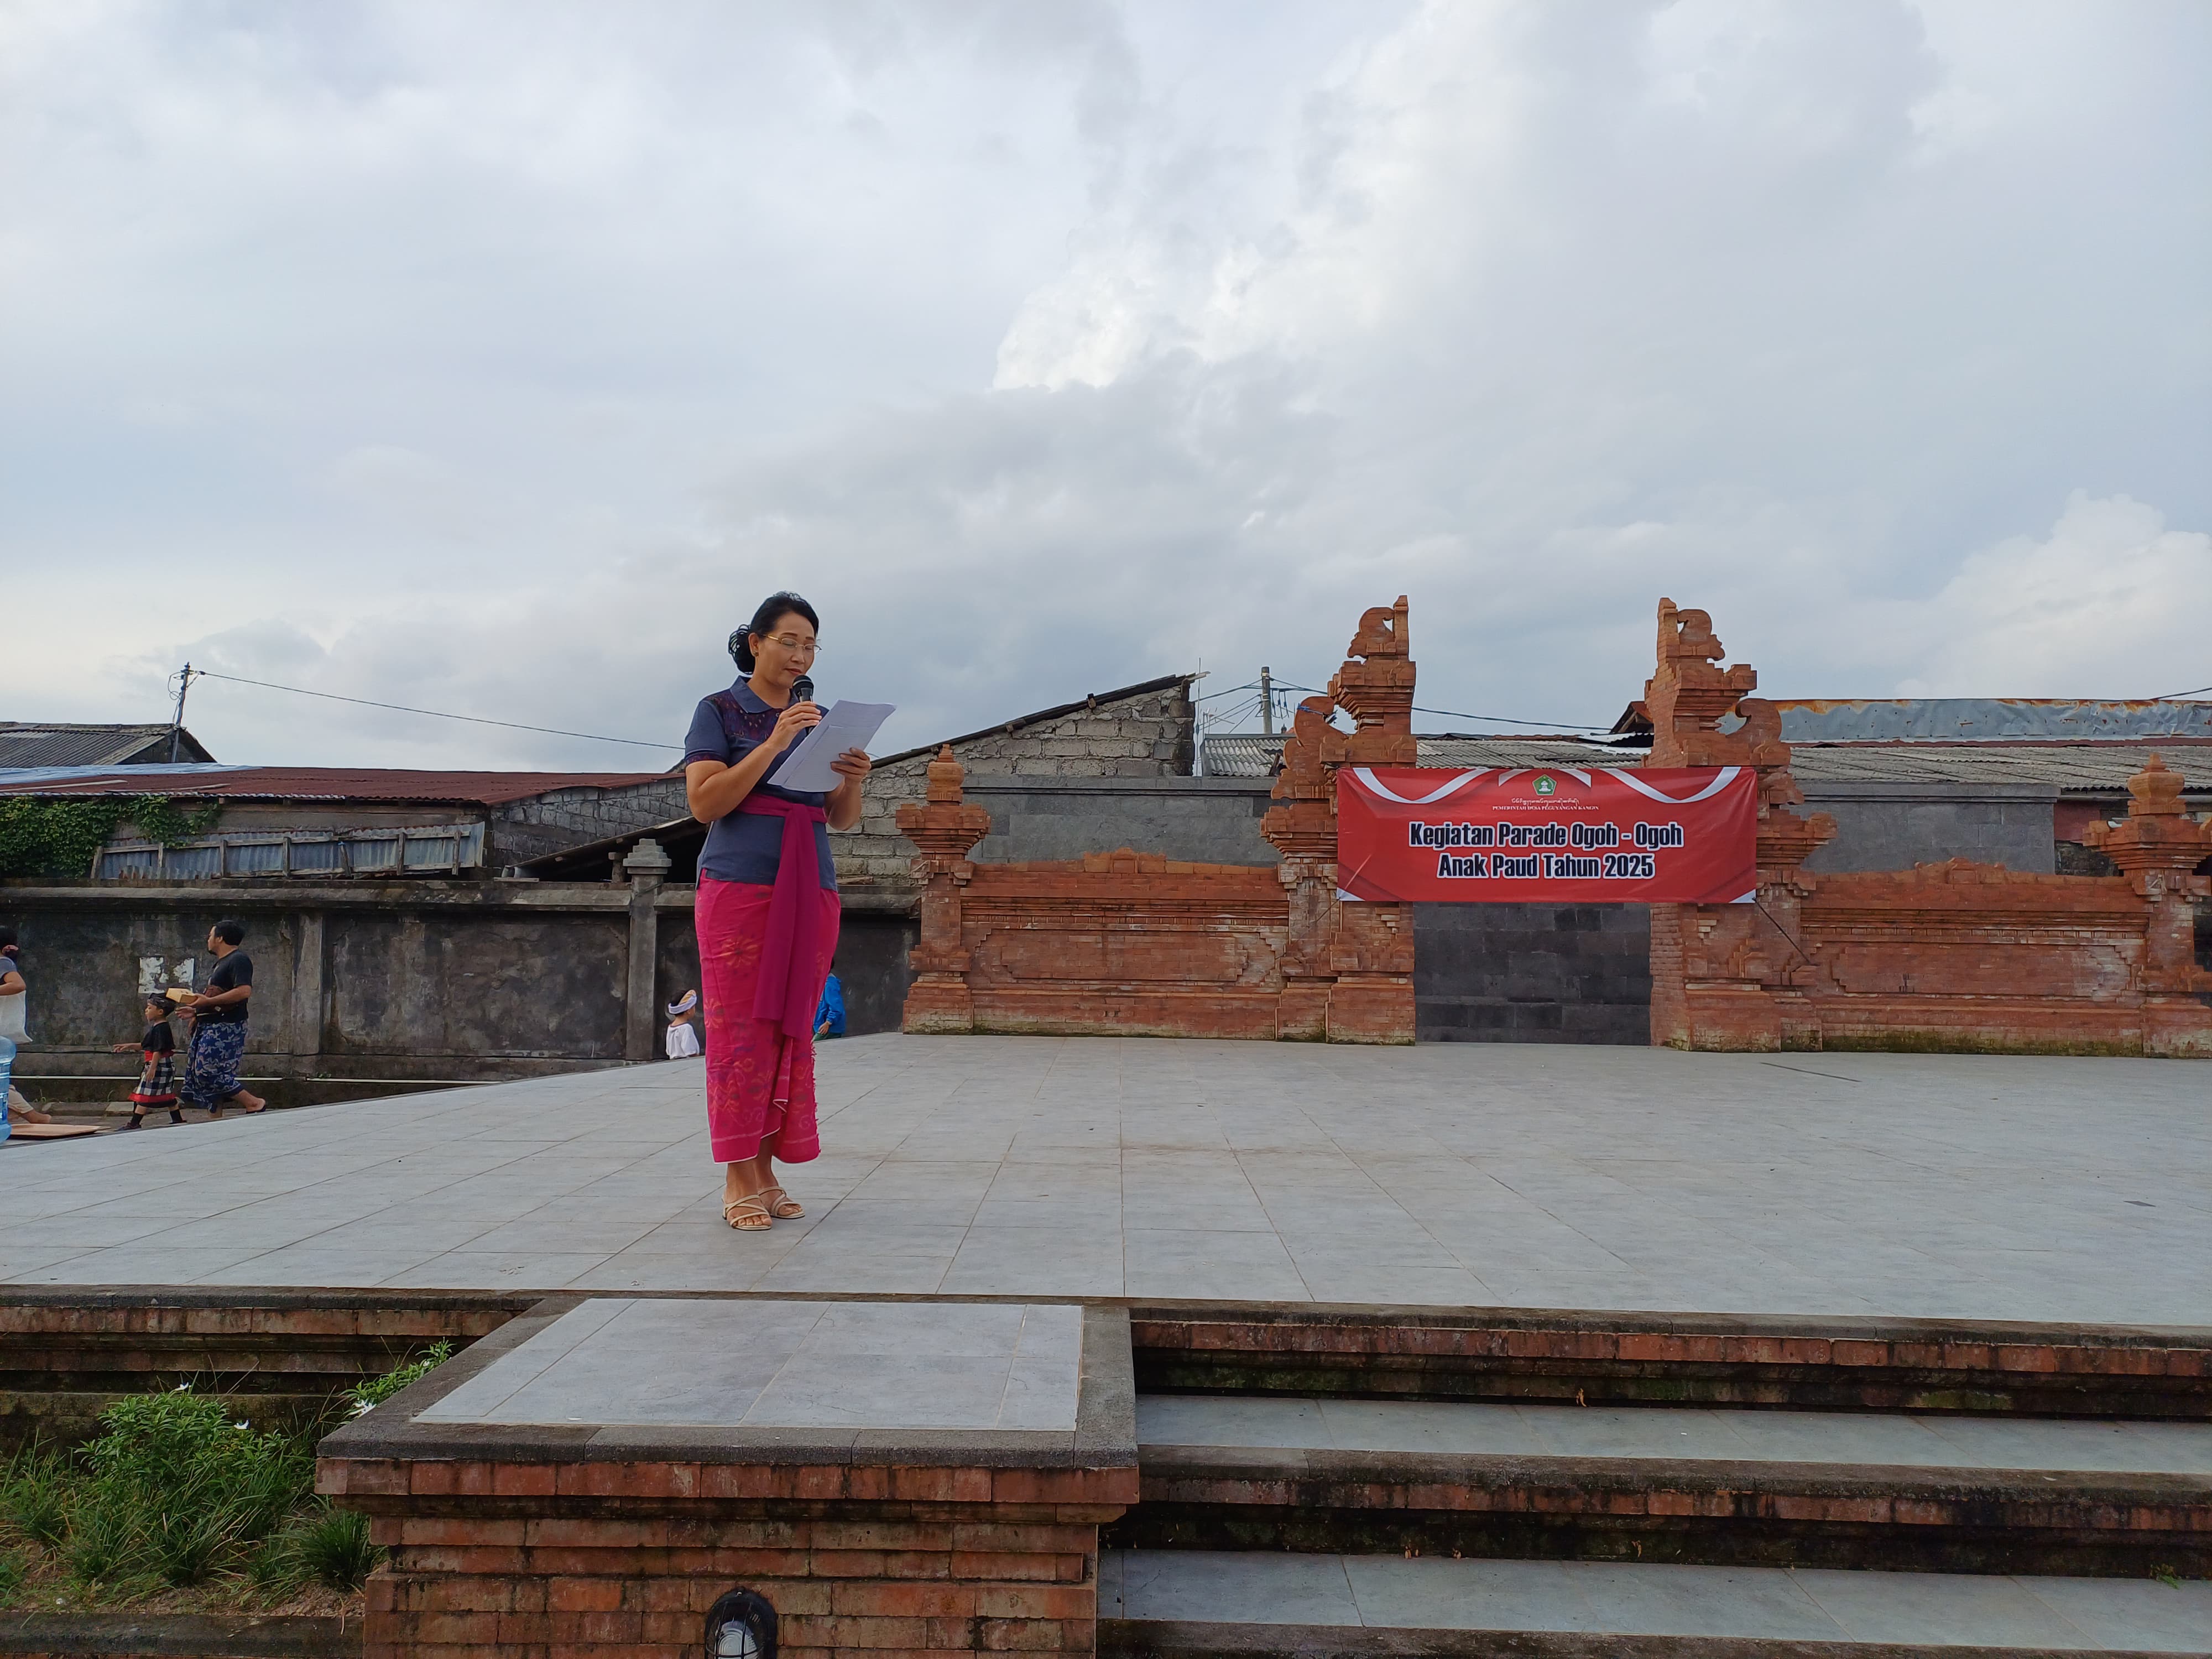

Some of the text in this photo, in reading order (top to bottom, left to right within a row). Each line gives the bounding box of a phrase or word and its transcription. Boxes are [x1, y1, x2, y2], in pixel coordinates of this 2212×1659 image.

[1409, 822, 1494, 851] Kegiatan
[1497, 822, 1568, 847] Parade
[1571, 822, 1619, 851] Ogoh
[1634, 822, 1684, 851] Ogoh
[1437, 853, 1655, 878] Anak Paud Tahun 2025
